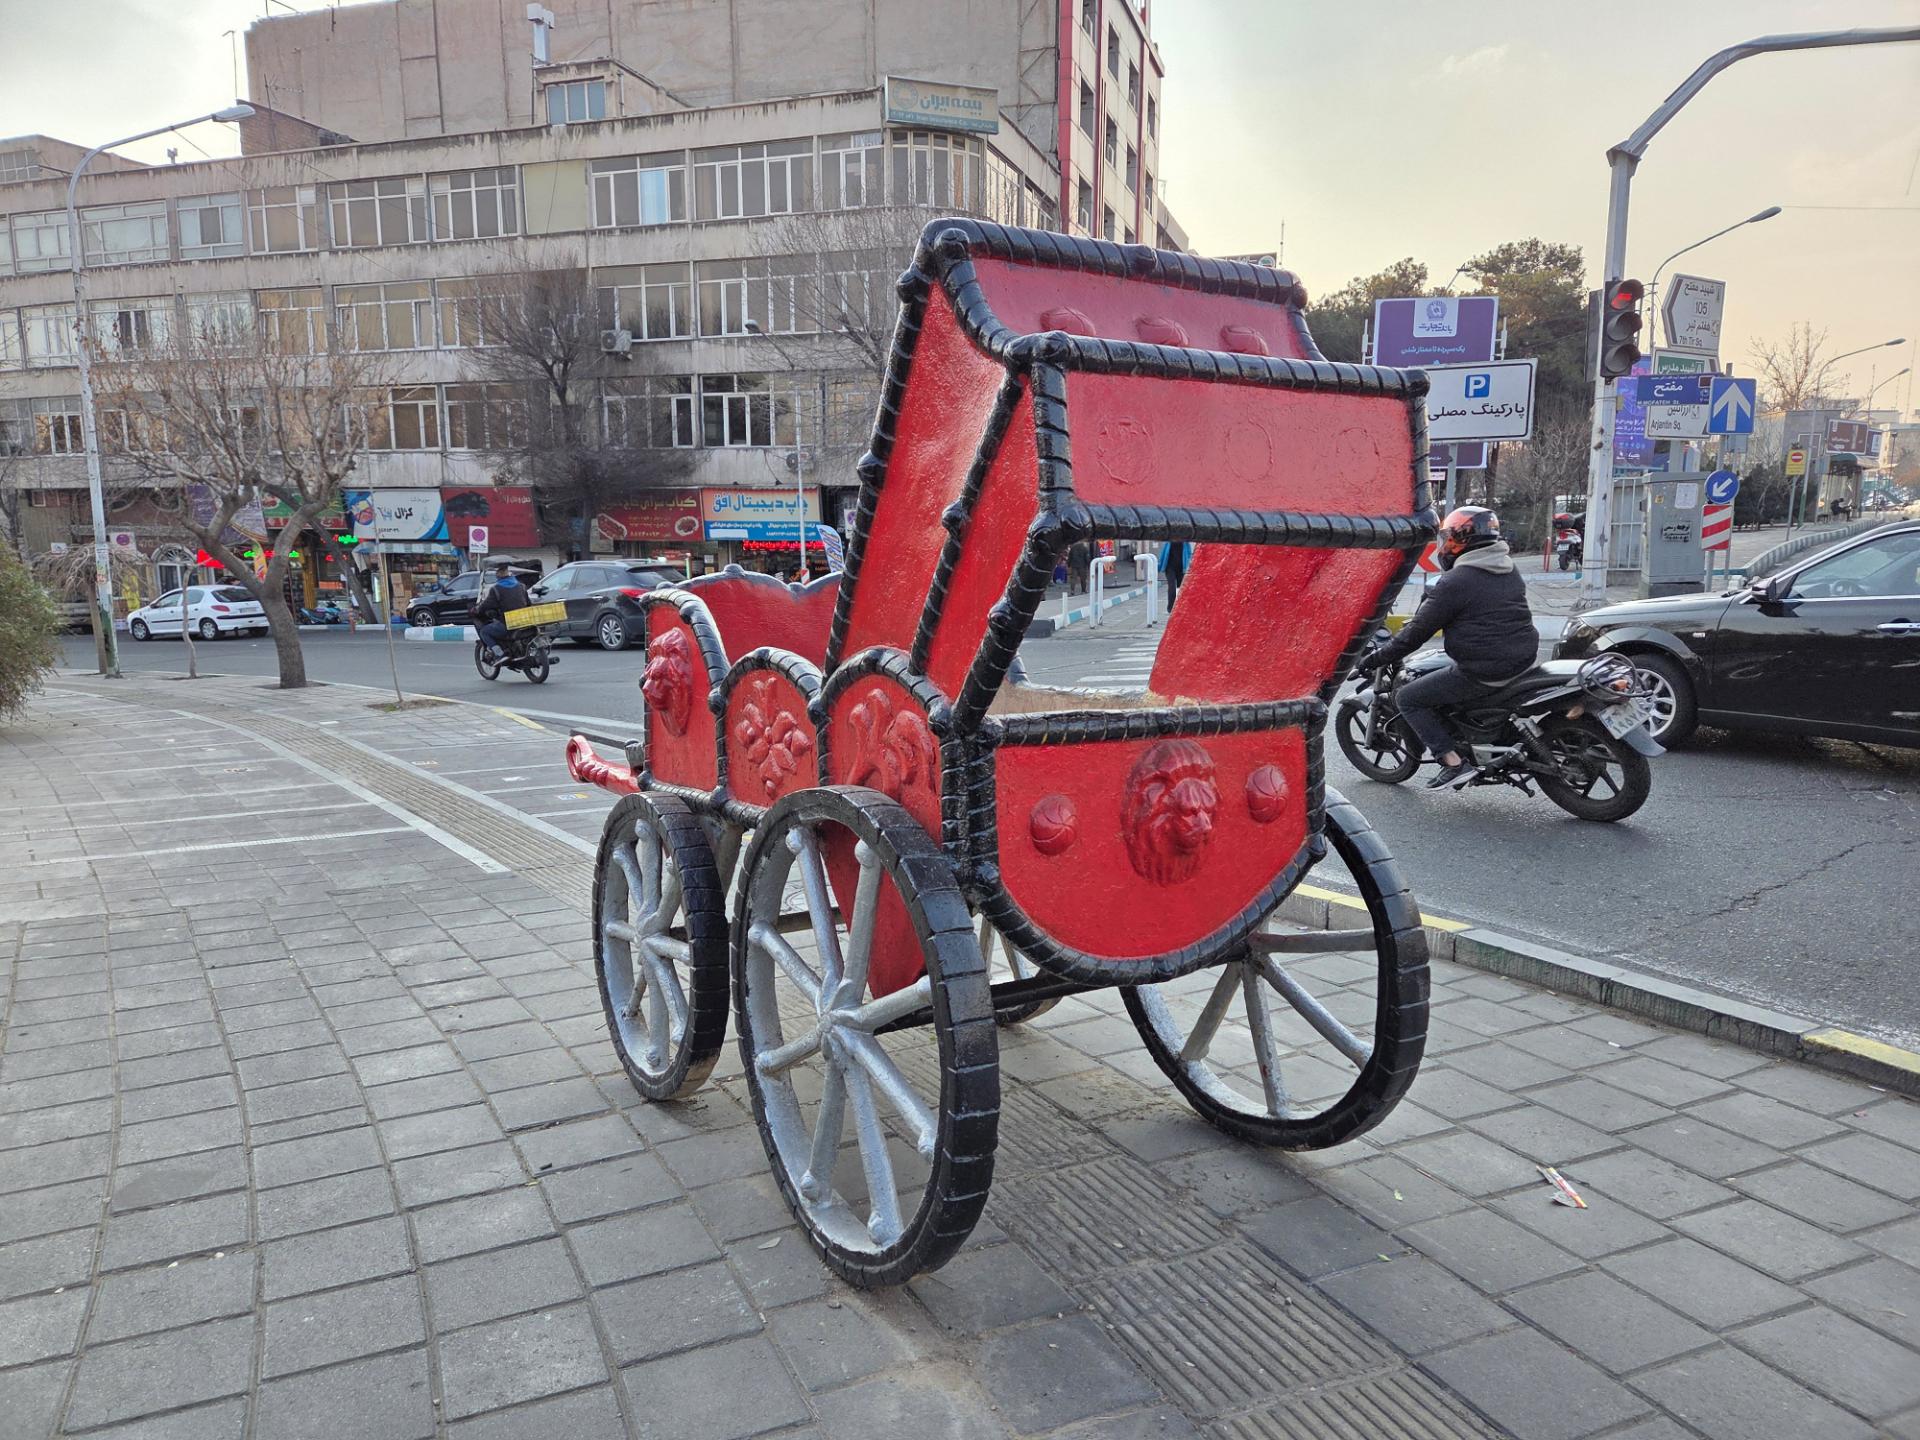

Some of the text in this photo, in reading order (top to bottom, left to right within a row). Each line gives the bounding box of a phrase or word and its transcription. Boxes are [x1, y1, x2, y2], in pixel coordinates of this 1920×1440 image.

[920, 94, 983, 116] بیمه ایران
[1684, 281, 1699, 296] مفتح
[1695, 301, 1708, 316] 105
[1418, 322, 1443, 332] تجارت
[1468, 375, 1486, 397] P
[1653, 380, 1684, 397] مفتح
[1428, 402, 1525, 421] پارکینگ مصلی
[666, 496, 697, 511] کباب
[713, 493, 732, 513] افق
[733, 493, 784, 513] دیجیتال
[394, 507, 413, 520] کژال
